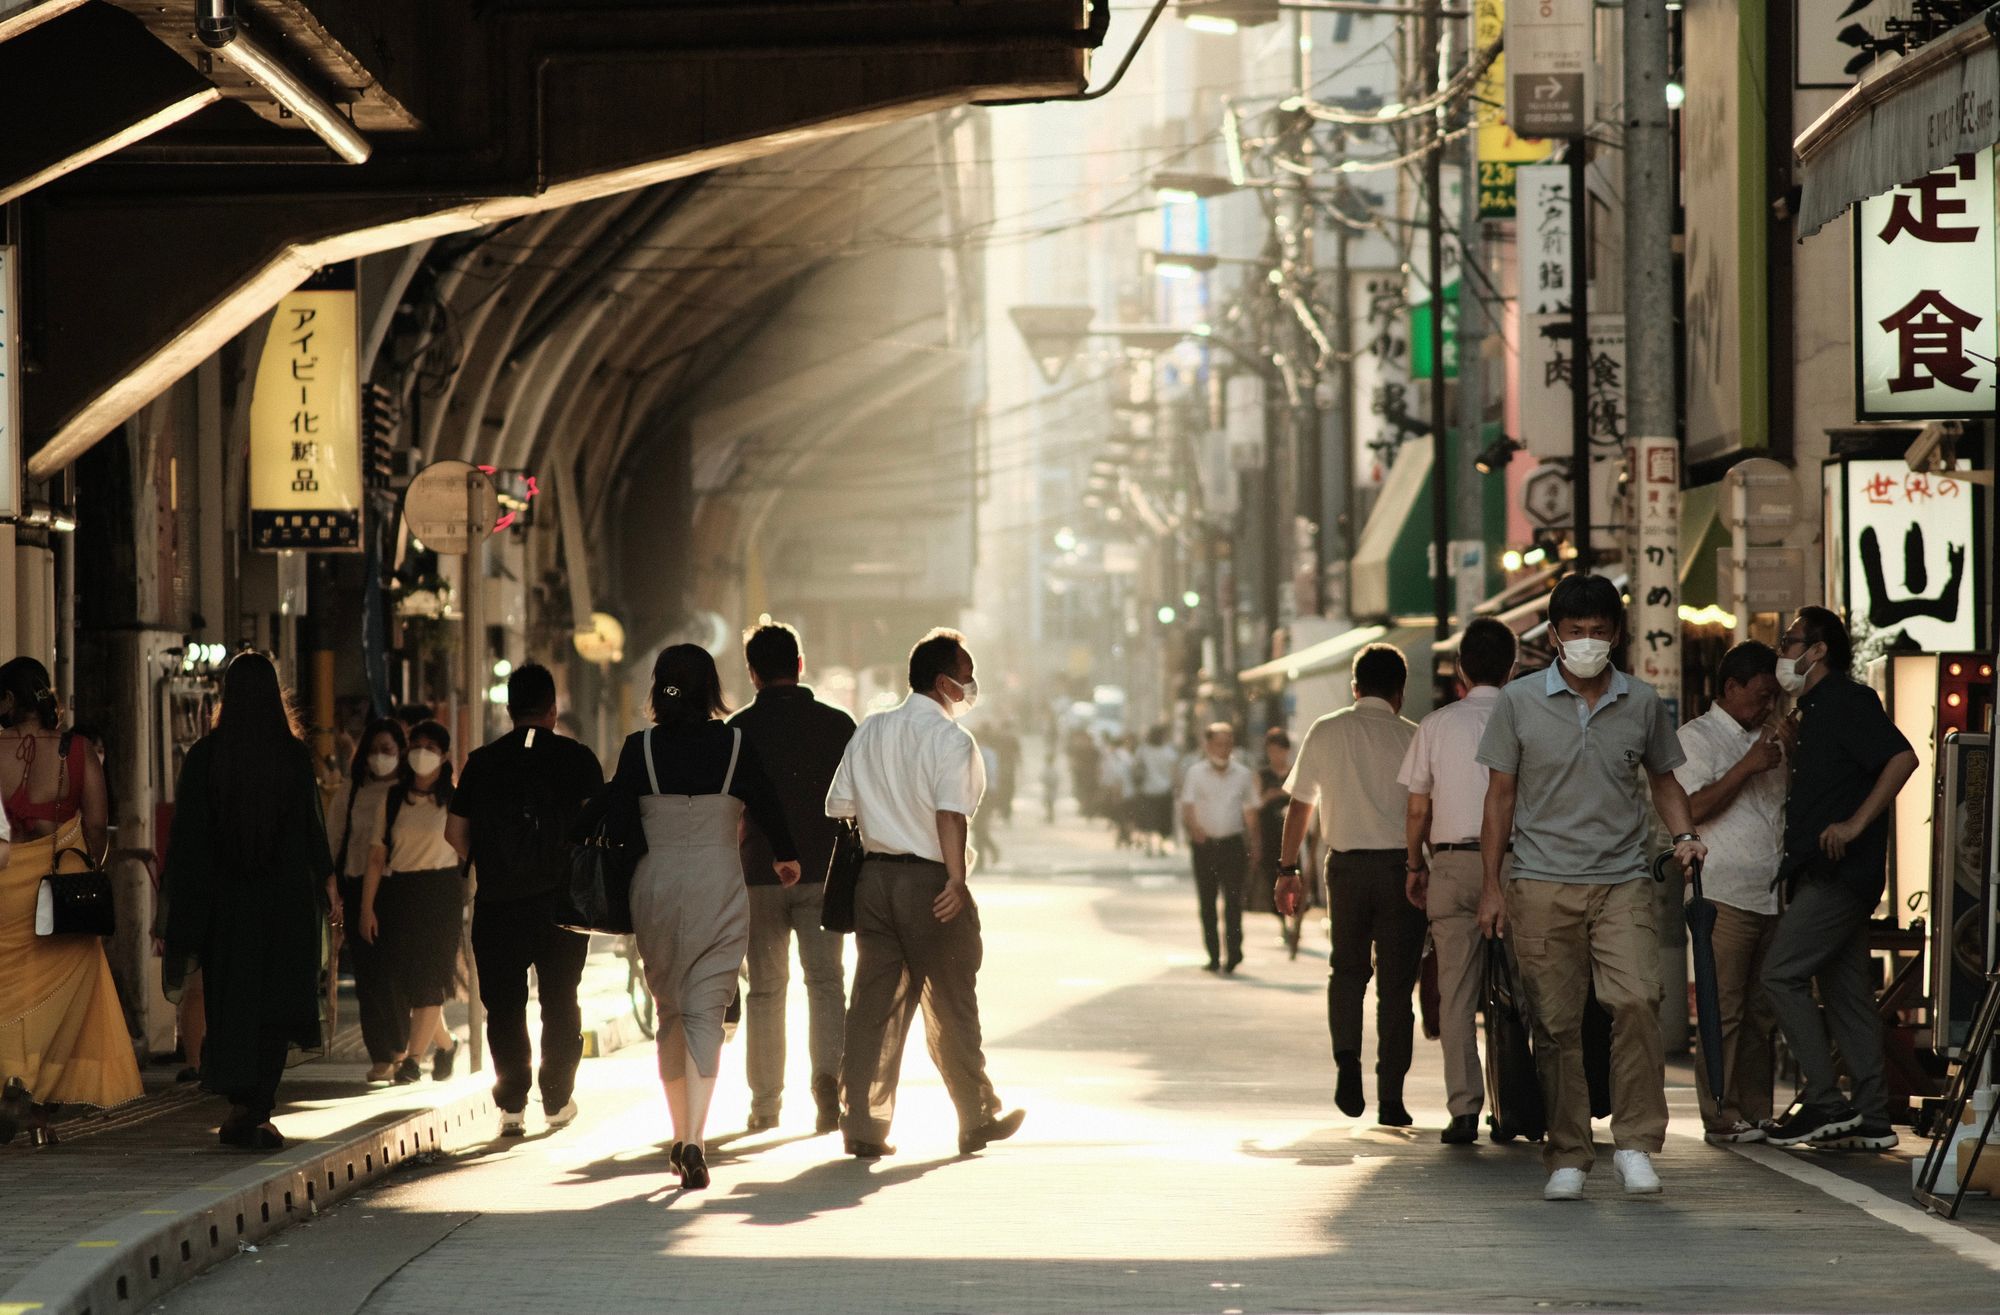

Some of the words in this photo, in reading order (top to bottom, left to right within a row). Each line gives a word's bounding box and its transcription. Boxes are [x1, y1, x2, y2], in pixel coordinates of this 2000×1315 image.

[1877, 153, 1983, 395] 定食
[289, 308, 319, 492] アイビー化粧品
[1861, 472, 1960, 506] 世界の
[1645, 545, 1674, 652] かめや
